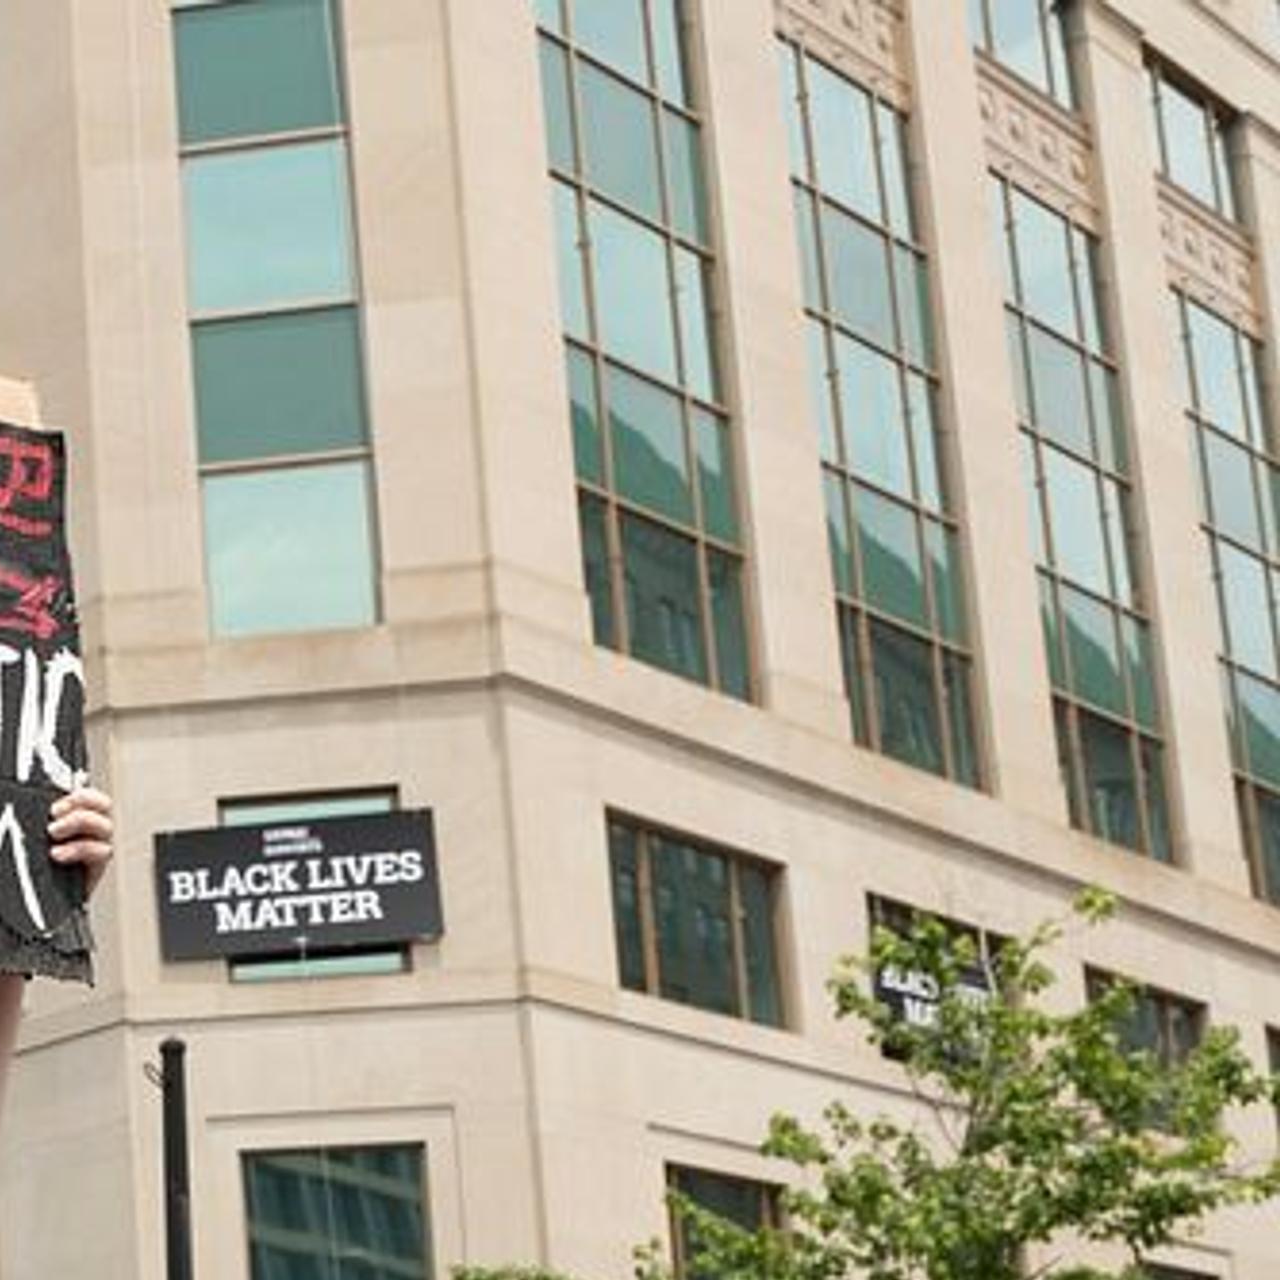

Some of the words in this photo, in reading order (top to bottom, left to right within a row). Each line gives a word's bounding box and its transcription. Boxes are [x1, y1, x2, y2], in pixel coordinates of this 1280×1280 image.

[169, 862, 300, 902] BLACK
[307, 851, 424, 891] LIVES
[216, 890, 383, 933] MATTER
